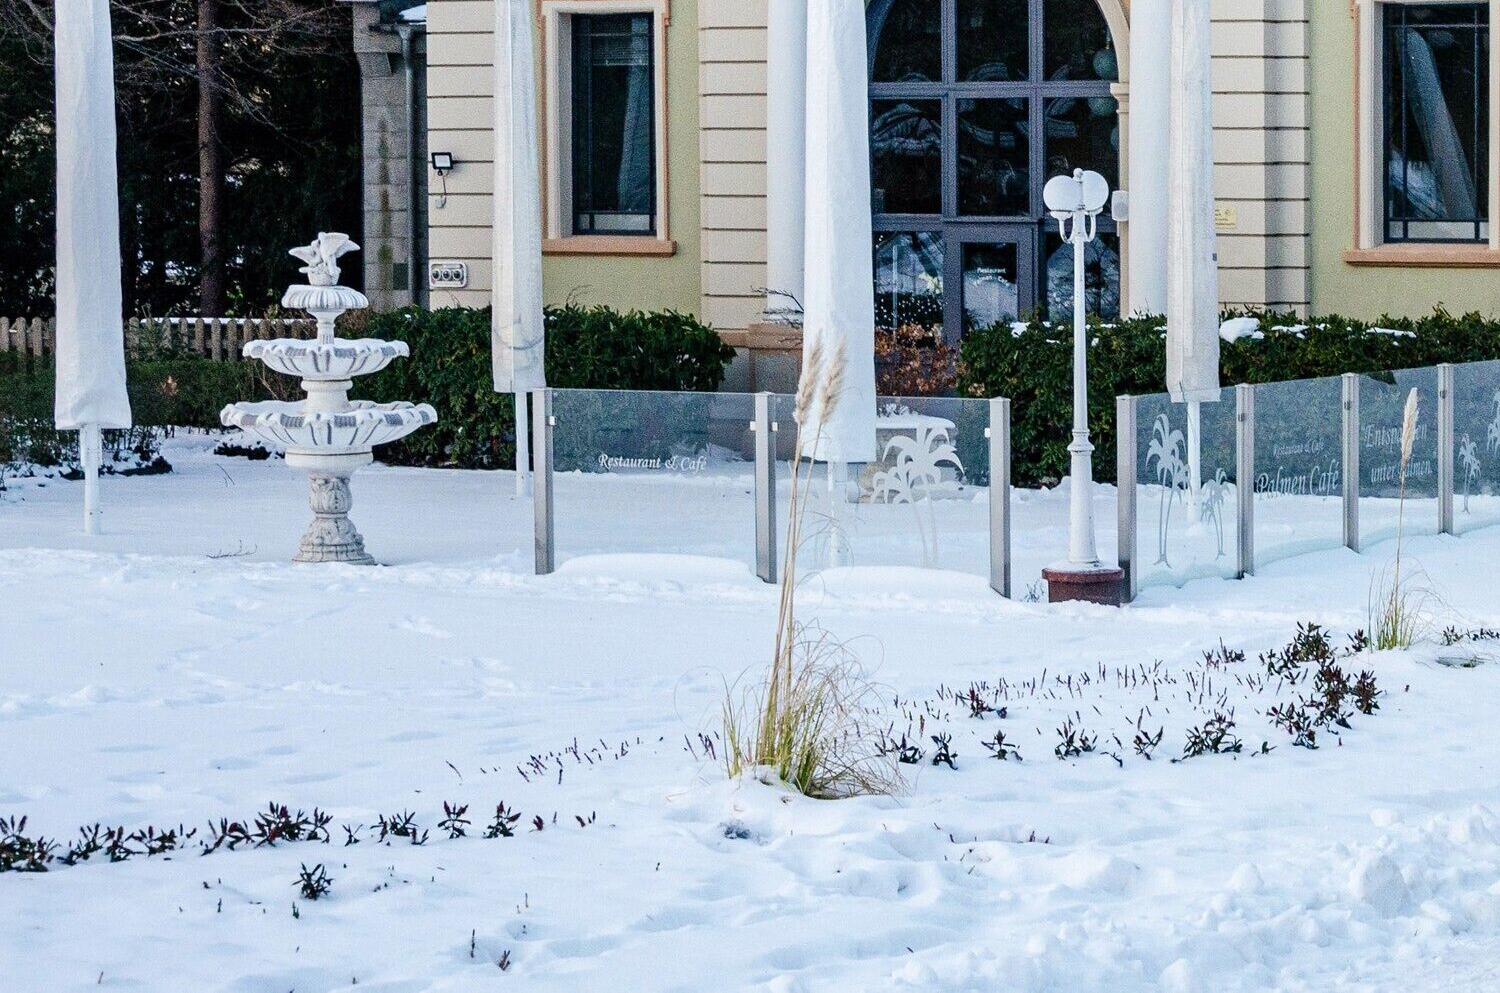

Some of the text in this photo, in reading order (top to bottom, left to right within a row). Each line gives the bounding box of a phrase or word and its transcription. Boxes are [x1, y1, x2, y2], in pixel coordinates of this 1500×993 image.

[598, 453, 707, 475] Restaurant & Café
[1256, 458, 1340, 501] Palmen Café
